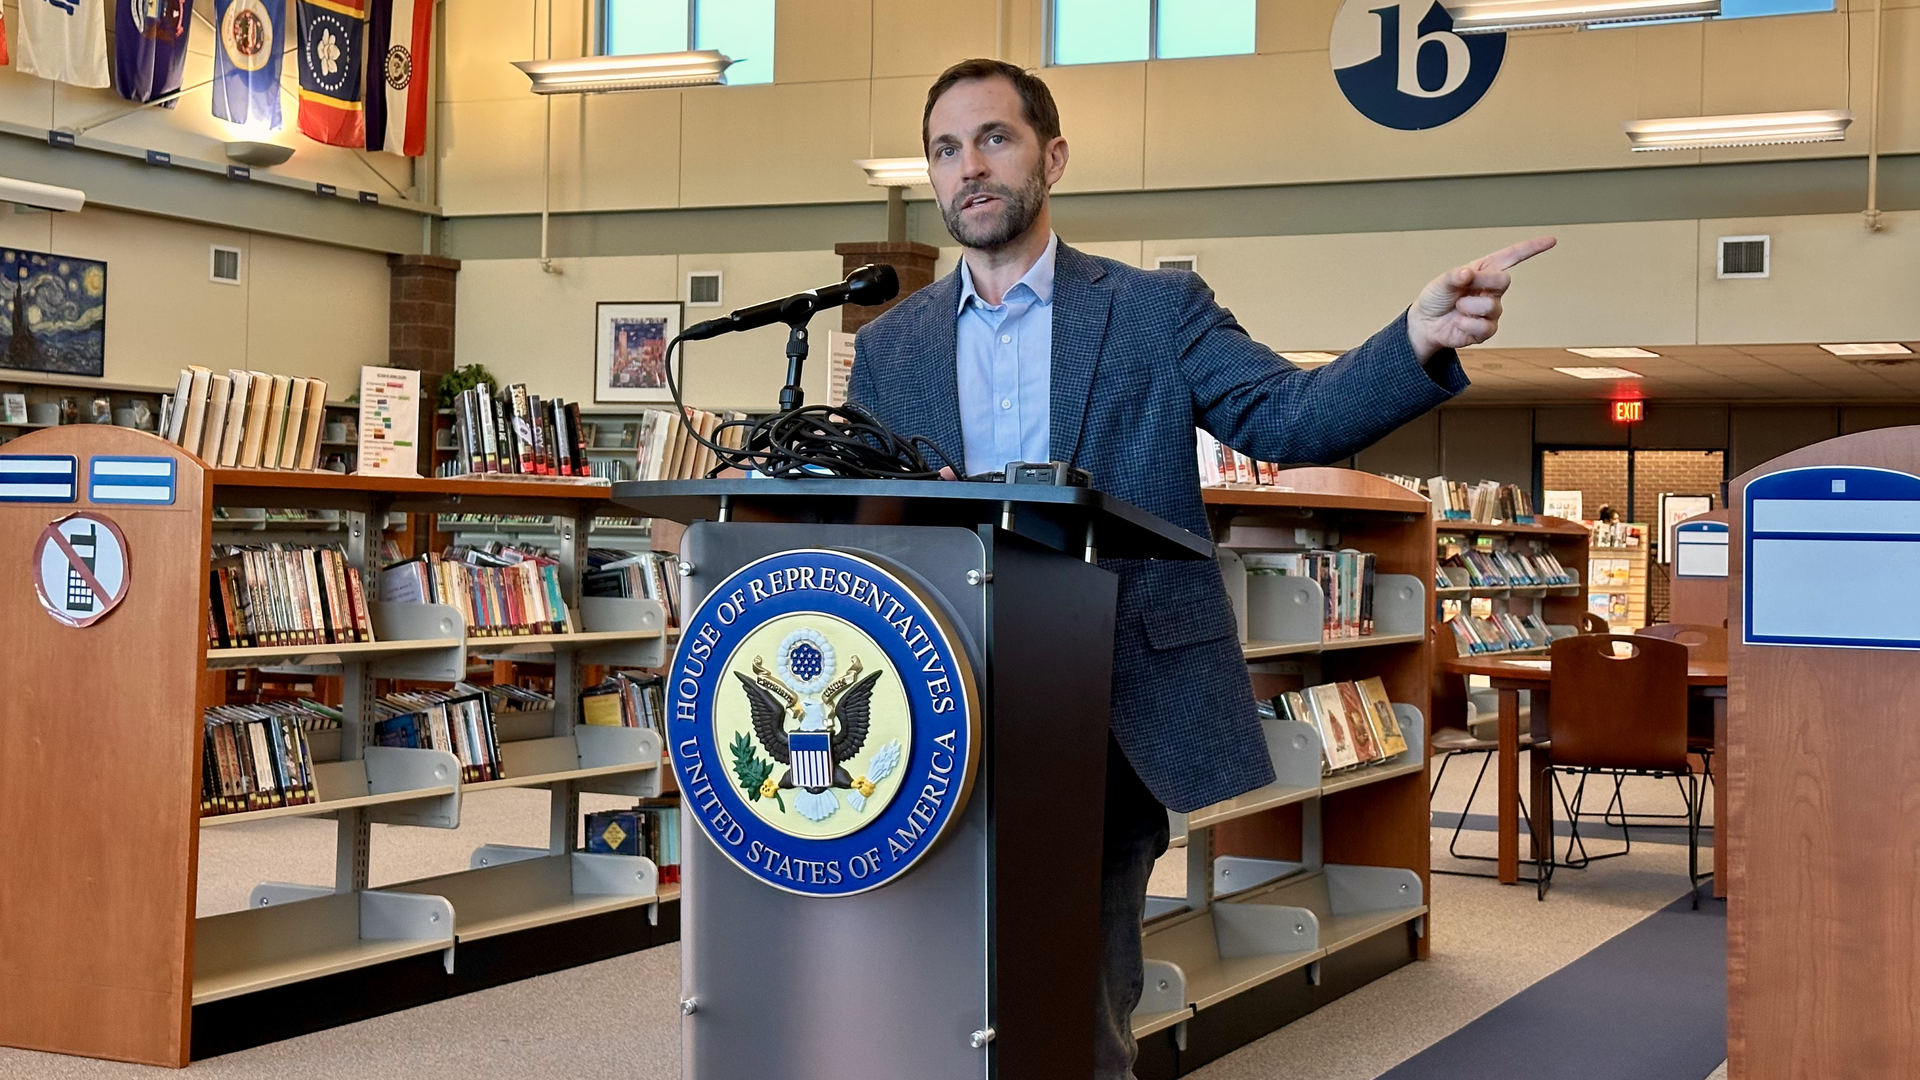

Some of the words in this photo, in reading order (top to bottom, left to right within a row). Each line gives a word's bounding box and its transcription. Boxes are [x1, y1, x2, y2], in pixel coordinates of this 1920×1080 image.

[1616, 402, 1641, 420] EXIT
[1673, 511, 1687, 522] NO
[676, 621, 721, 722] HOUSE
[716, 588, 748, 627] OF
[748, 566, 956, 715] REPRESENTATIVES
[679, 736, 745, 847] UNITED
[746, 840, 843, 885] STATES
[848, 847, 882, 880] OF
[887, 729, 956, 862] AMERICA
